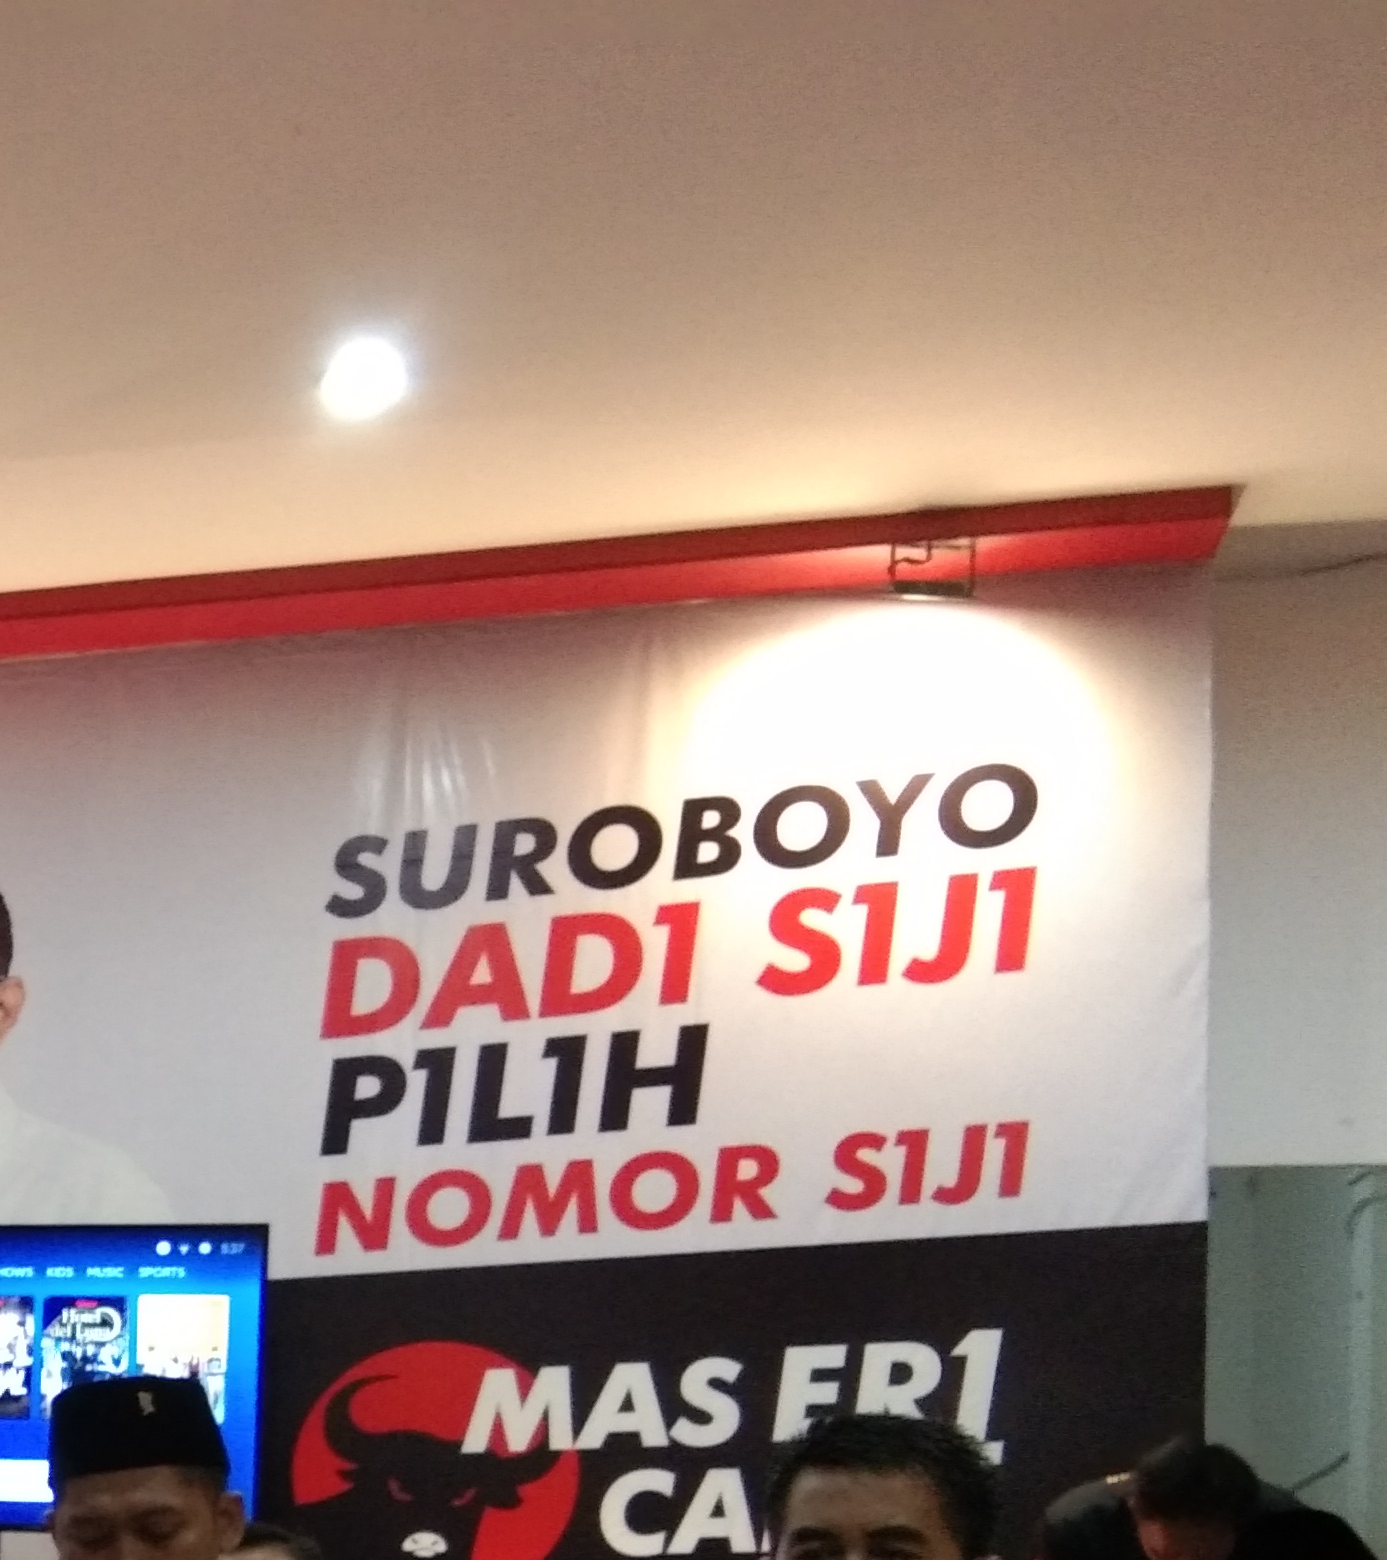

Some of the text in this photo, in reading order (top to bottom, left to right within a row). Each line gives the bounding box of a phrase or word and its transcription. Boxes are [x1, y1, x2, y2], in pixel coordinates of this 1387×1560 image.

[325, 762, 1039, 919] SUROBOYO
[319, 866, 1038, 1041] DAD1 S1J1
[319, 1022, 711, 1157] P1L1H
[314, 1120, 1031, 1257] NOMOR S1J1
[46, 1267, 74, 1278] KIDS
[86, 1267, 124, 1278] MUSIC
[138, 1267, 186, 1278] SPORTS
[460, 1357, 744, 1455] MAS
[599, 1468, 771, 1558] CA
